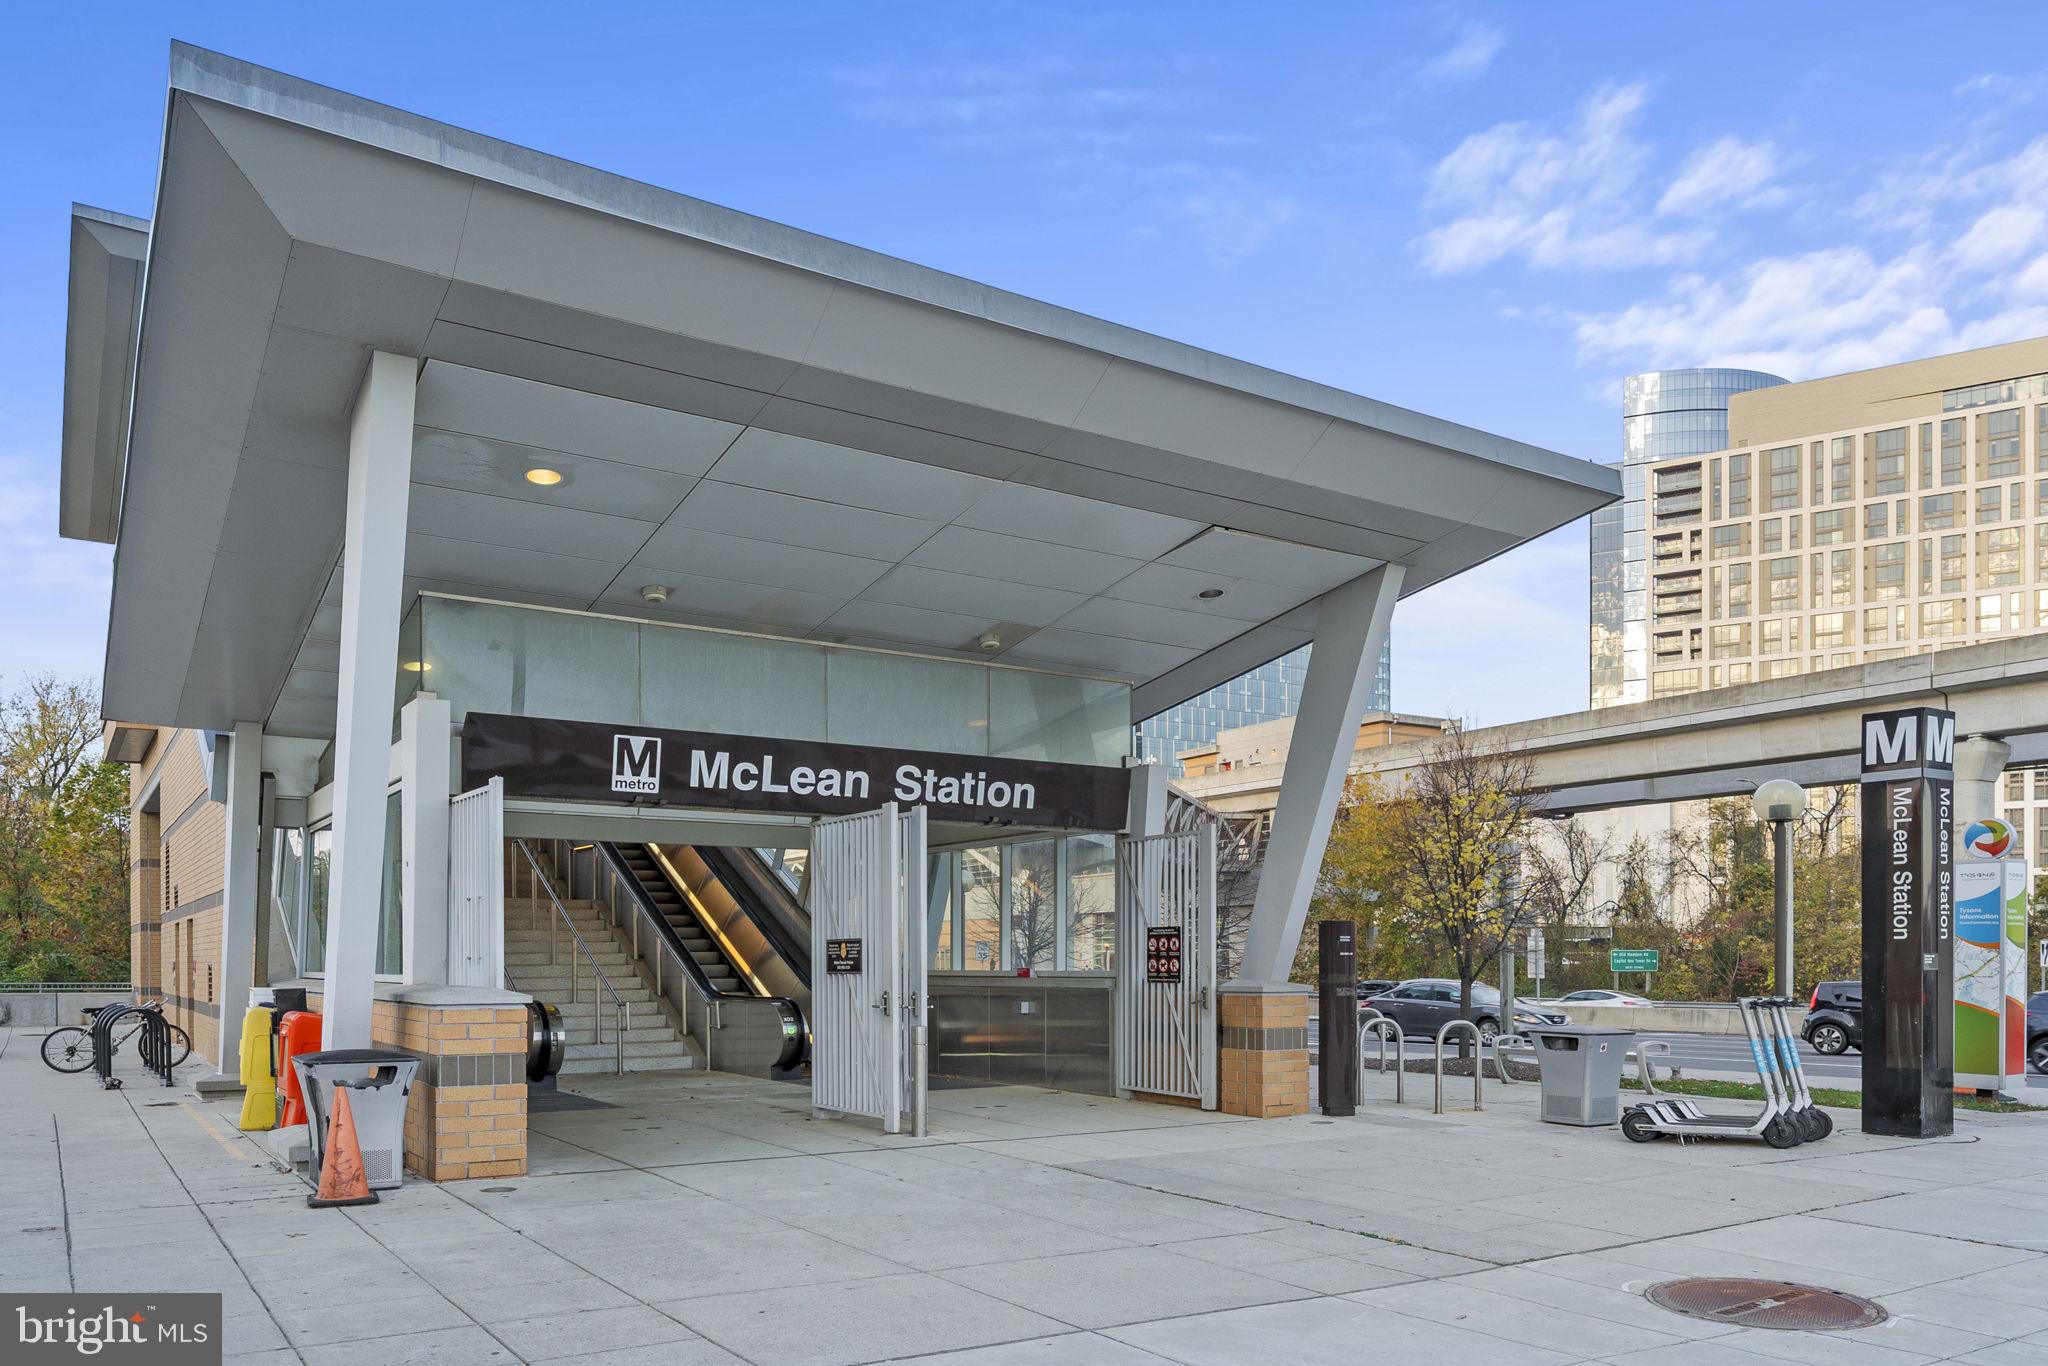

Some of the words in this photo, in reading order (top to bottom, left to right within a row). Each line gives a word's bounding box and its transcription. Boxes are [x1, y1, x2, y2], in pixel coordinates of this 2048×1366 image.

[616, 737, 658, 778] M
[1866, 716, 1917, 765] M
[1926, 715, 1954, 764] M
[615, 779, 656, 790] metro
[689, 749, 870, 799] McLean
[894, 764, 1036, 809] Station
[1893, 787, 1913, 865] McLean
[1940, 788, 1951, 865] McLean
[1893, 871, 1913, 940] Station
[1940, 871, 1951, 939] Station
